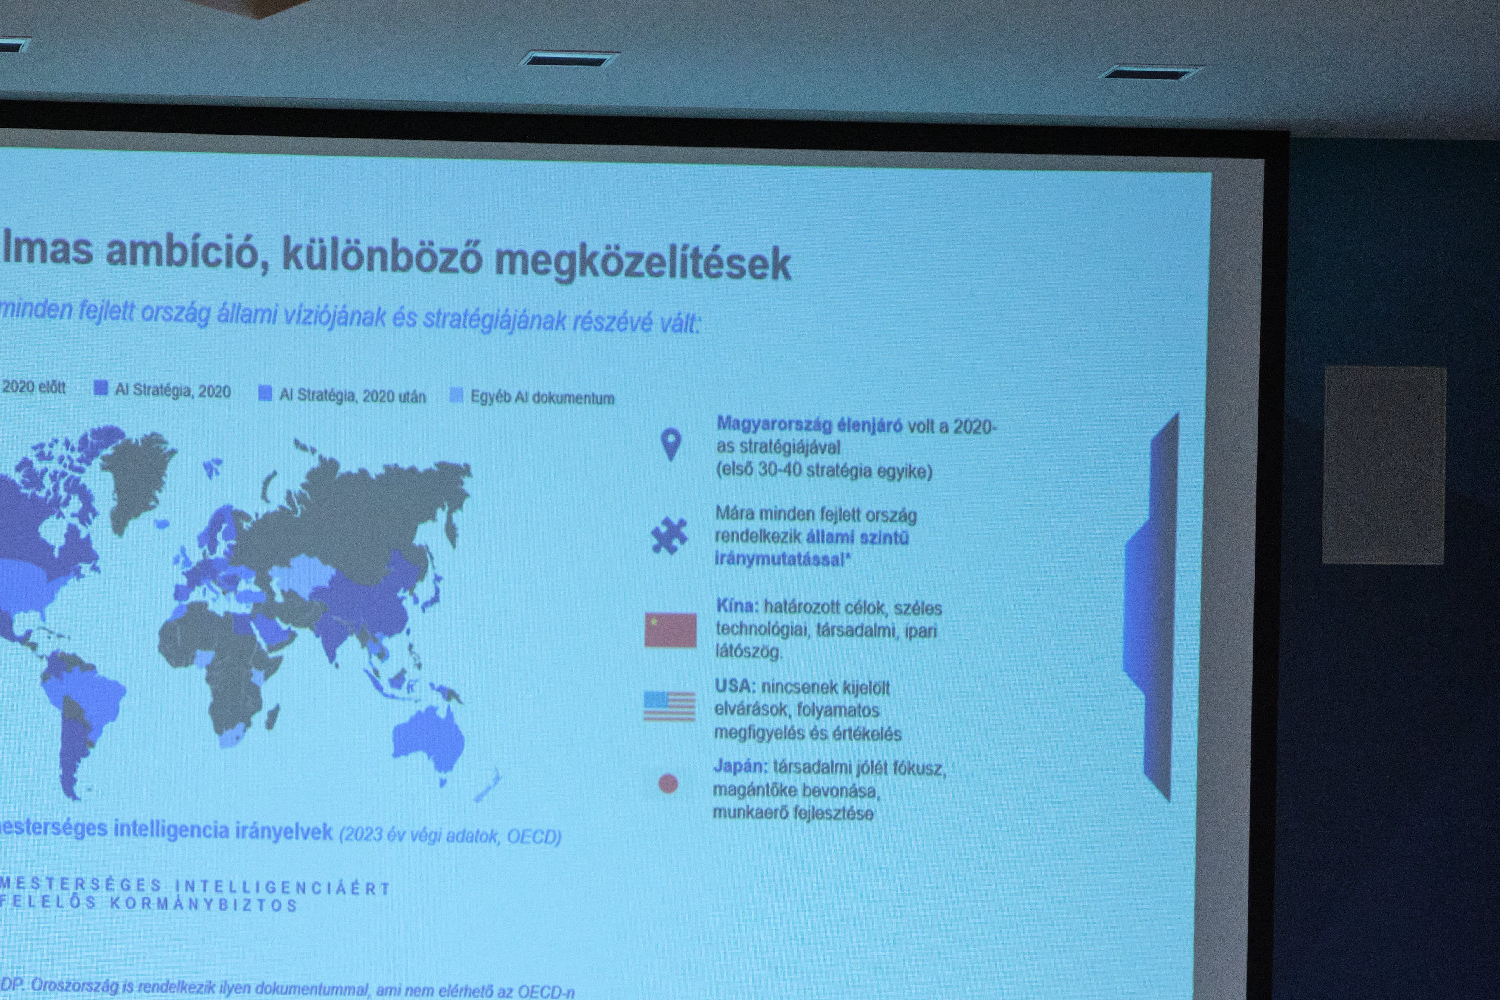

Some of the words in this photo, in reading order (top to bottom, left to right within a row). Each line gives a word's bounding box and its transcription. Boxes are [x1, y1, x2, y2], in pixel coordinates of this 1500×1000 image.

[106, 232, 268, 276] ambíció,
[283, 234, 482, 273] különböző
[496, 242, 792, 285] megközelítések
[78, 298, 135, 325] fejlett
[141, 301, 210, 329] ország
[217, 302, 277, 324] állami
[284, 303, 386, 331] víziójának
[392, 306, 417, 328] és
[422, 308, 566, 335] stratégiájának
[573, 312, 653, 332] részévé
[3, 380, 34, 393] 2020
[115, 383, 129, 395] AI
[133, 382, 194, 399] Stratégia,
[199, 384, 231, 398] 2020
[280, 387, 293, 401] AI
[297, 387, 358, 404] Stratégia,
[363, 389, 394, 403] 2020
[399, 389, 426, 404] után
[471, 389, 511, 406] Egyéb
[515, 390, 528, 404] AI
[532, 390, 615, 405] dokumentum
[718, 415, 832, 435] Magyarország
[837, 417, 903, 436] élenjáró
[908, 419, 935, 433] volt
[940, 423, 949, 433] a
[954, 419, 997, 434] 2020-
[717, 441, 734, 453] as
[739, 439, 840, 456] stratégiájával
[758, 462, 802, 477] 30-40
[807, 464, 872, 479] stratégia
[877, 464, 933, 481] egyike)
[716, 506, 755, 521] Mára
[759, 506, 815, 521] minden
[820, 507, 861, 524] fejlett
[865, 508, 917, 525] ország
[715, 528, 801, 544] rendelkezik
[806, 529, 855, 544] állami
[717, 598, 759, 613] Kína:
[764, 600, 840, 614] határozott
[845, 600, 888, 616] célok,
[894, 601, 942, 615] széles
[816, 622, 900, 639] társadalmi,
[715, 679, 756, 693] USA:
[762, 680, 838, 695] nincsenek
[843, 680, 890, 697] kijelölt
[715, 702, 792, 719] elvárások,
[797, 703, 880, 720] folyamatos
[715, 725, 805, 743] megfigyelés
[810, 726, 828, 740] és
[832, 726, 902, 741] értékelés
[714, 758, 769, 776] Japán:
[773, 759, 852, 774] társadalmi
[856, 761, 888, 777] jólét
[893, 761, 947, 778] fókusz,
[802, 783, 881, 800] bevonása,
[794, 806, 874, 822] fejlesztése
[114, 819, 229, 841] intelligencia
[236, 821, 332, 843] irányelvek
[339, 826, 382, 844] (2023
[388, 827, 405, 842] év
[411, 827, 442, 846] végi
[446, 828, 501, 846] adatok,
[508, 828, 562, 848] OECD)
[0, 875, 161, 891] MESTERSÉGES
[176, 879, 390, 896] INTELLIGENCIÁÉRT
[111, 894, 297, 912] KORMÁNYBIZTOS
[31, 977, 118, 994] Oroszország
[122, 979, 134, 993] is
[138, 979, 215, 995] rendelkezik
[219, 980, 251, 998] ilyen
[255, 981, 372, 999] dokumentummal,
[376, 983, 401, 998] ami
[405, 984, 434, 998] nem
[498, 986, 513, 999] az
[518, 985, 575, 999] OECD-n
